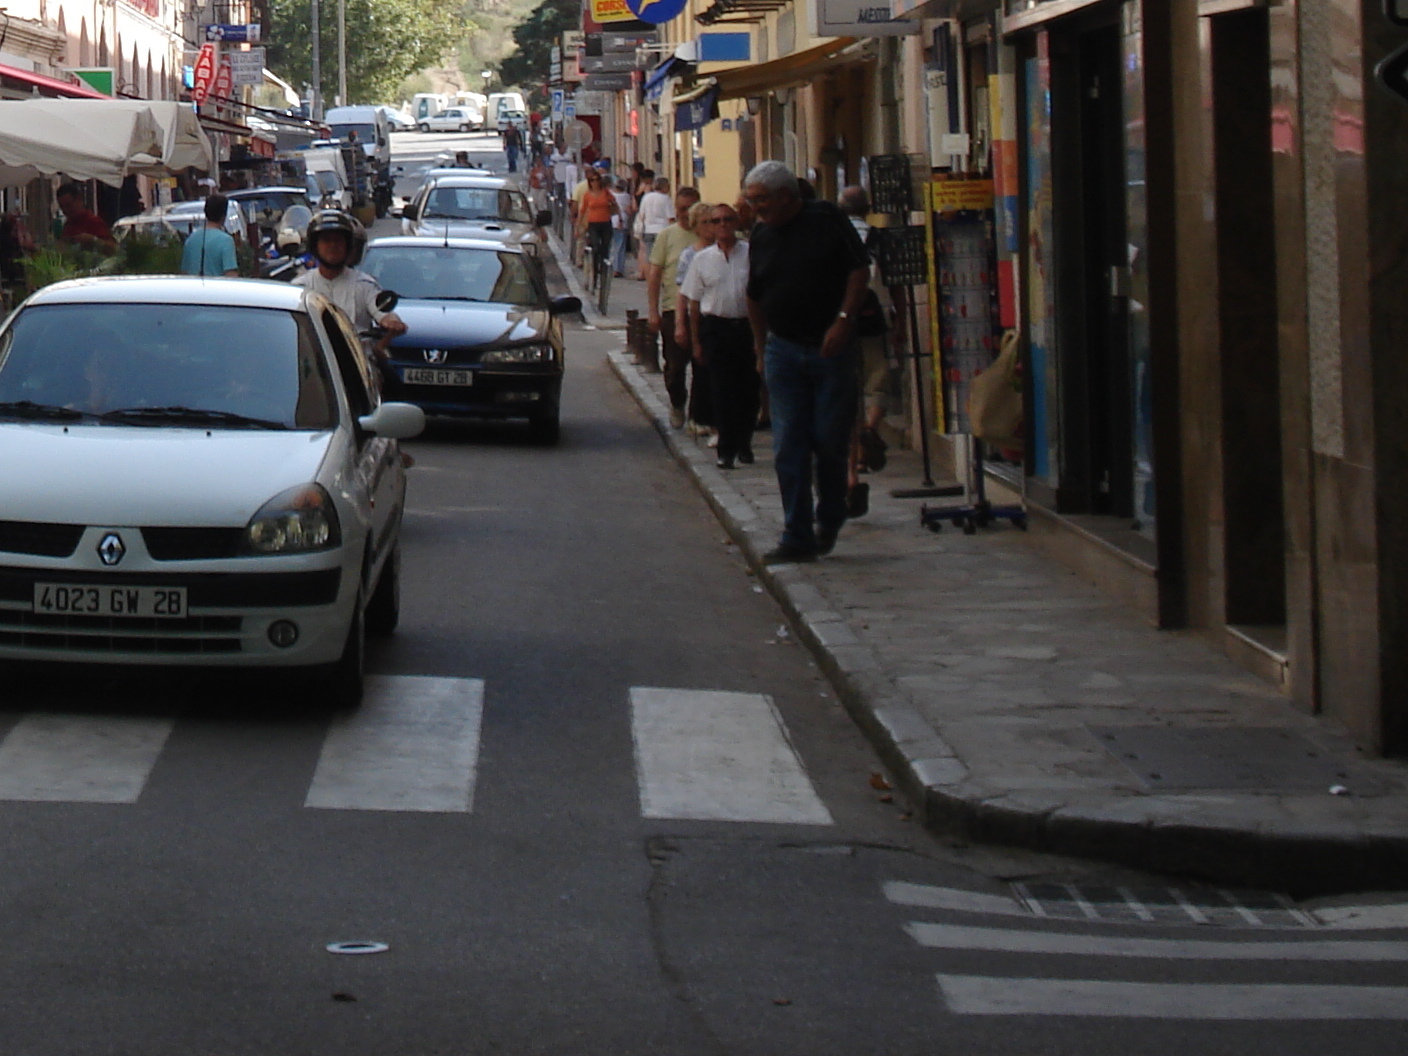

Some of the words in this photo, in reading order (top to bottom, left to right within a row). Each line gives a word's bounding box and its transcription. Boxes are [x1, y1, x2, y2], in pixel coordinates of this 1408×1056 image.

[194, 45, 214, 101] TABAC
[40, 587, 100, 612] 4023
[110, 589, 139, 613] GW
[154, 591, 181, 614] 2B
